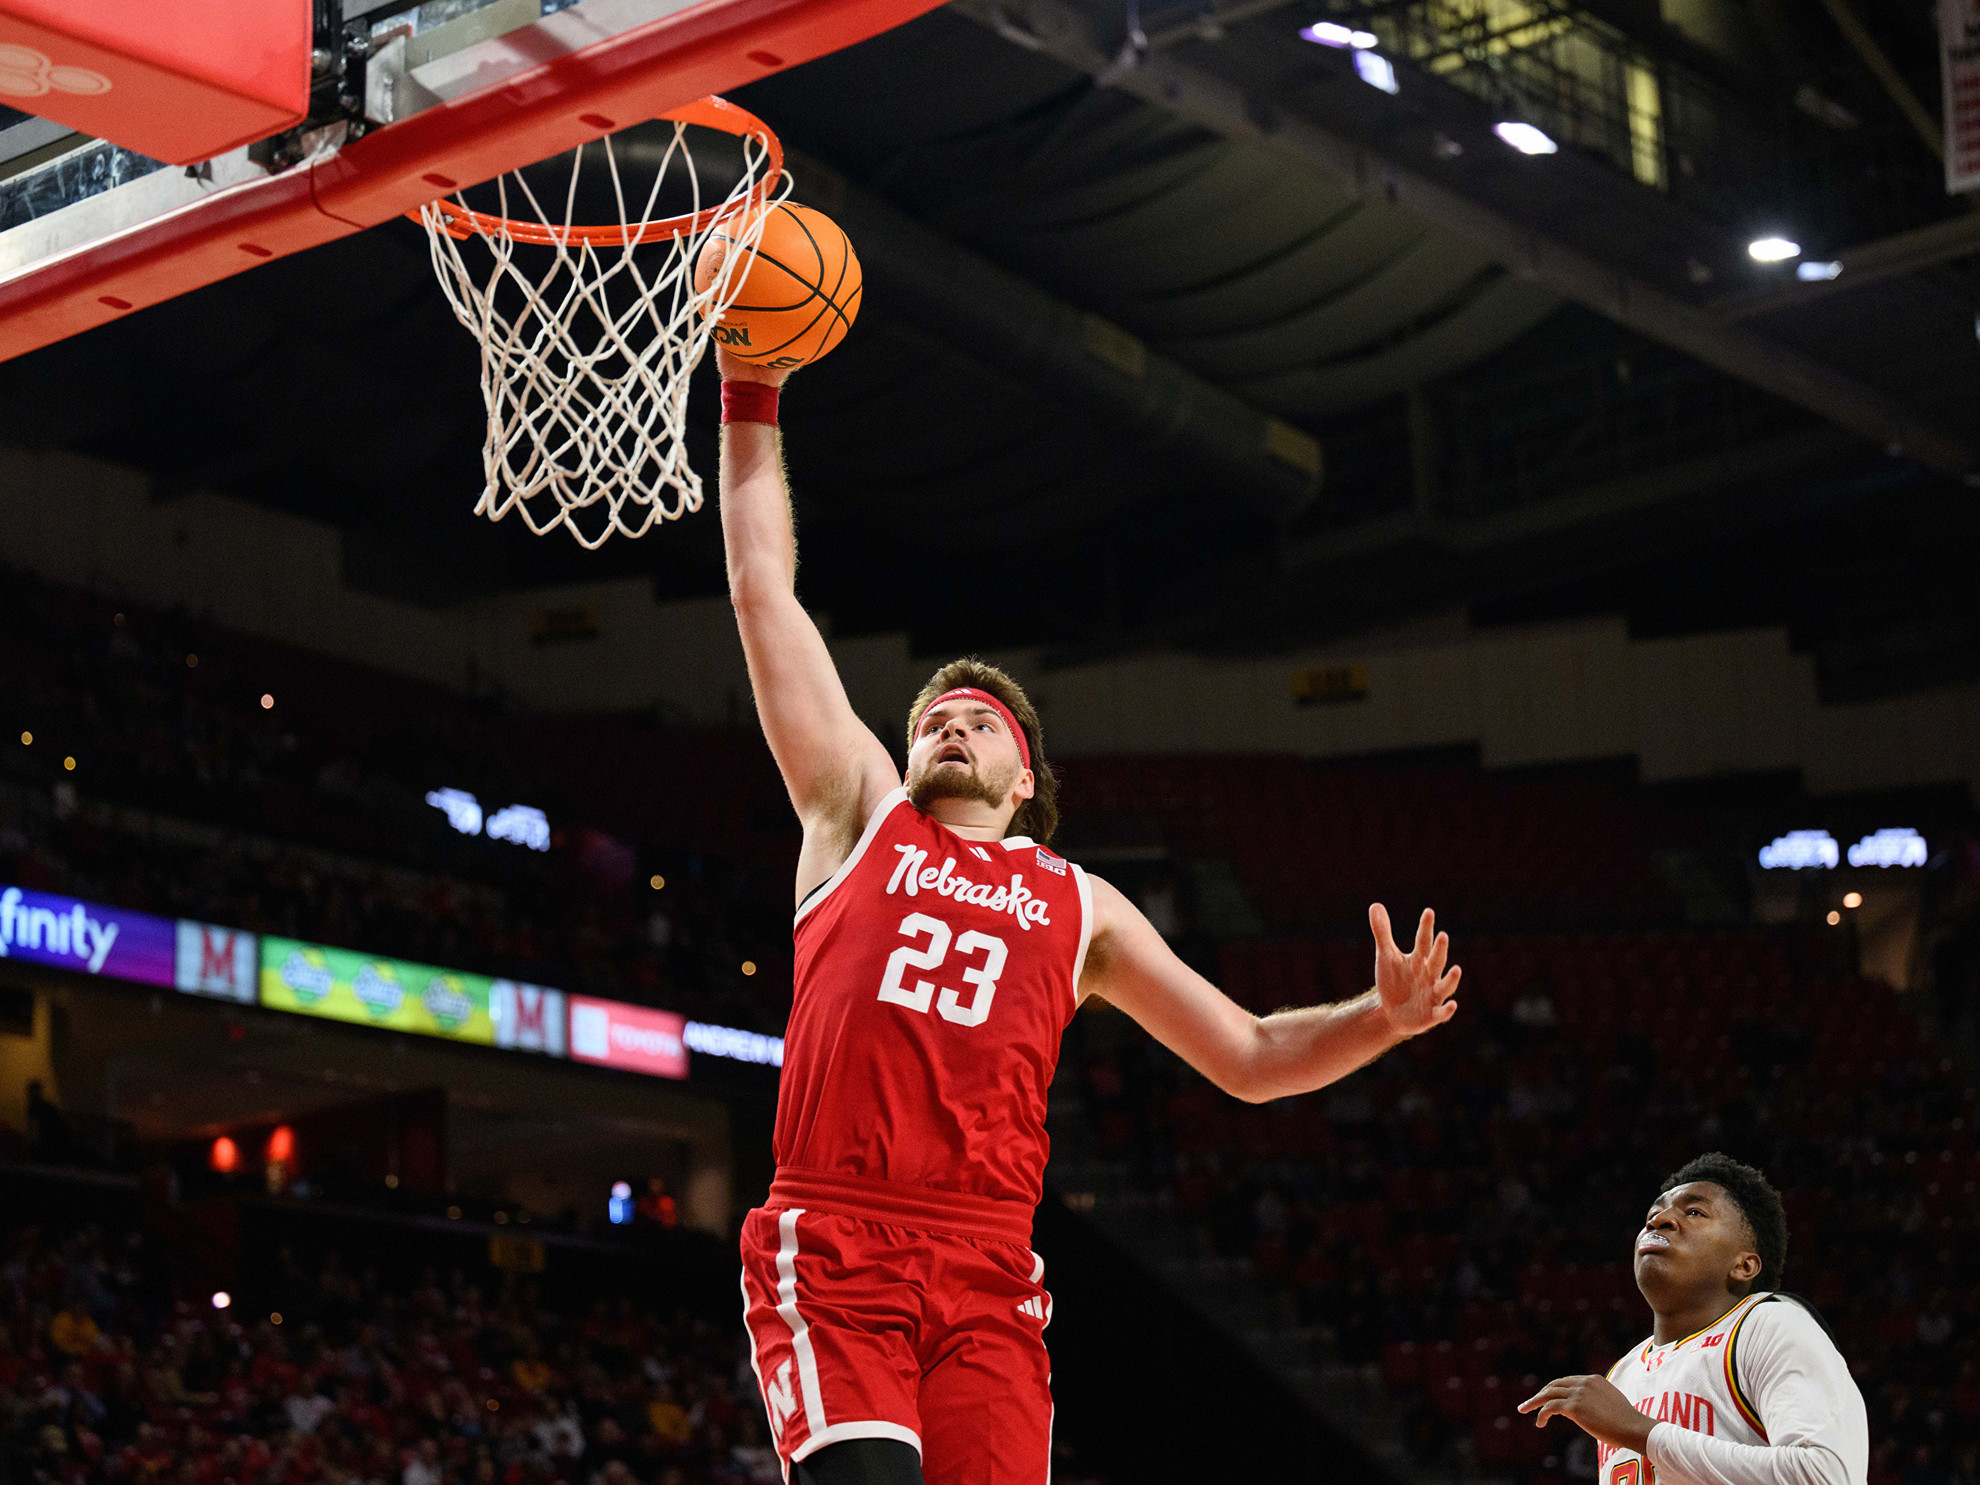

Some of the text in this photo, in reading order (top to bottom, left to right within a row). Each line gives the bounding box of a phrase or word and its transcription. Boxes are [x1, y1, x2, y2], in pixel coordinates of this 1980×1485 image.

[886, 844, 1050, 930] Nebraska
[202, 927, 235, 985] M
[877, 912, 1009, 1027] 23
[514, 985, 546, 1041] M
[767, 1355, 798, 1441] N
